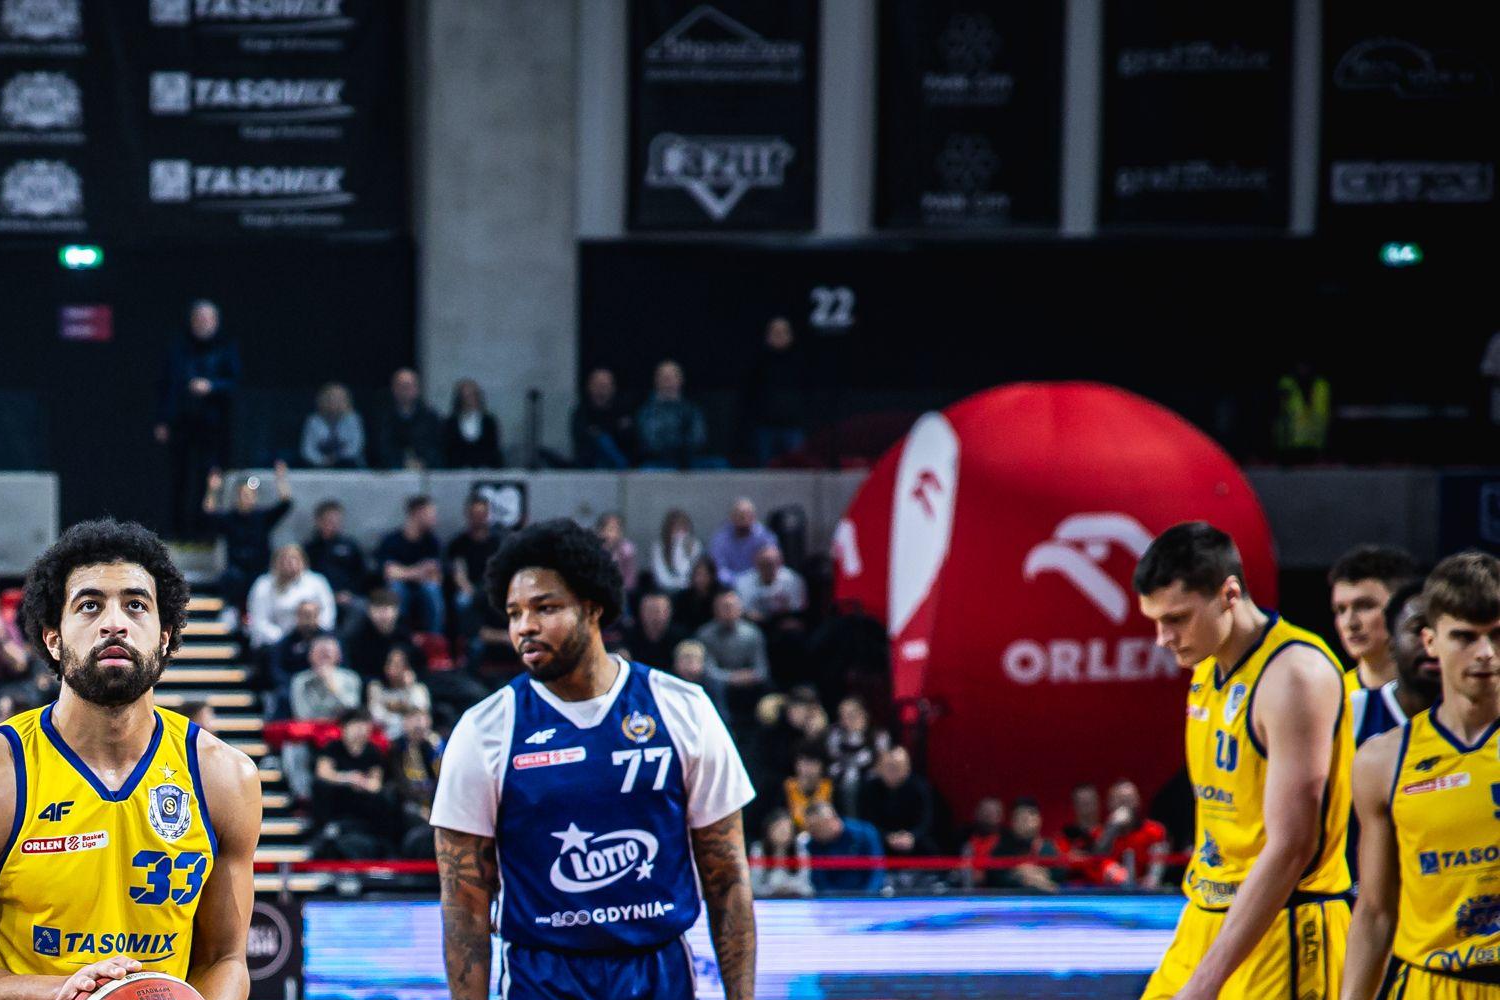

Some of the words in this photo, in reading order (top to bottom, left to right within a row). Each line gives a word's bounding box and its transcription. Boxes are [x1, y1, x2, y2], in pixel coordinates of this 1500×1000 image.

[809, 287, 856, 328] 22
[611, 747, 673, 793] 77
[38, 801, 75, 822] 4F
[24, 840, 62, 851] ORLEN
[82, 832, 105, 842] Basket
[82, 841, 97, 849] Liga
[570, 840, 640, 881] LOTTO
[129, 850, 208, 906] 33
[591, 901, 665, 924] GDYNIA
[64, 932, 179, 955] TASOMIX
